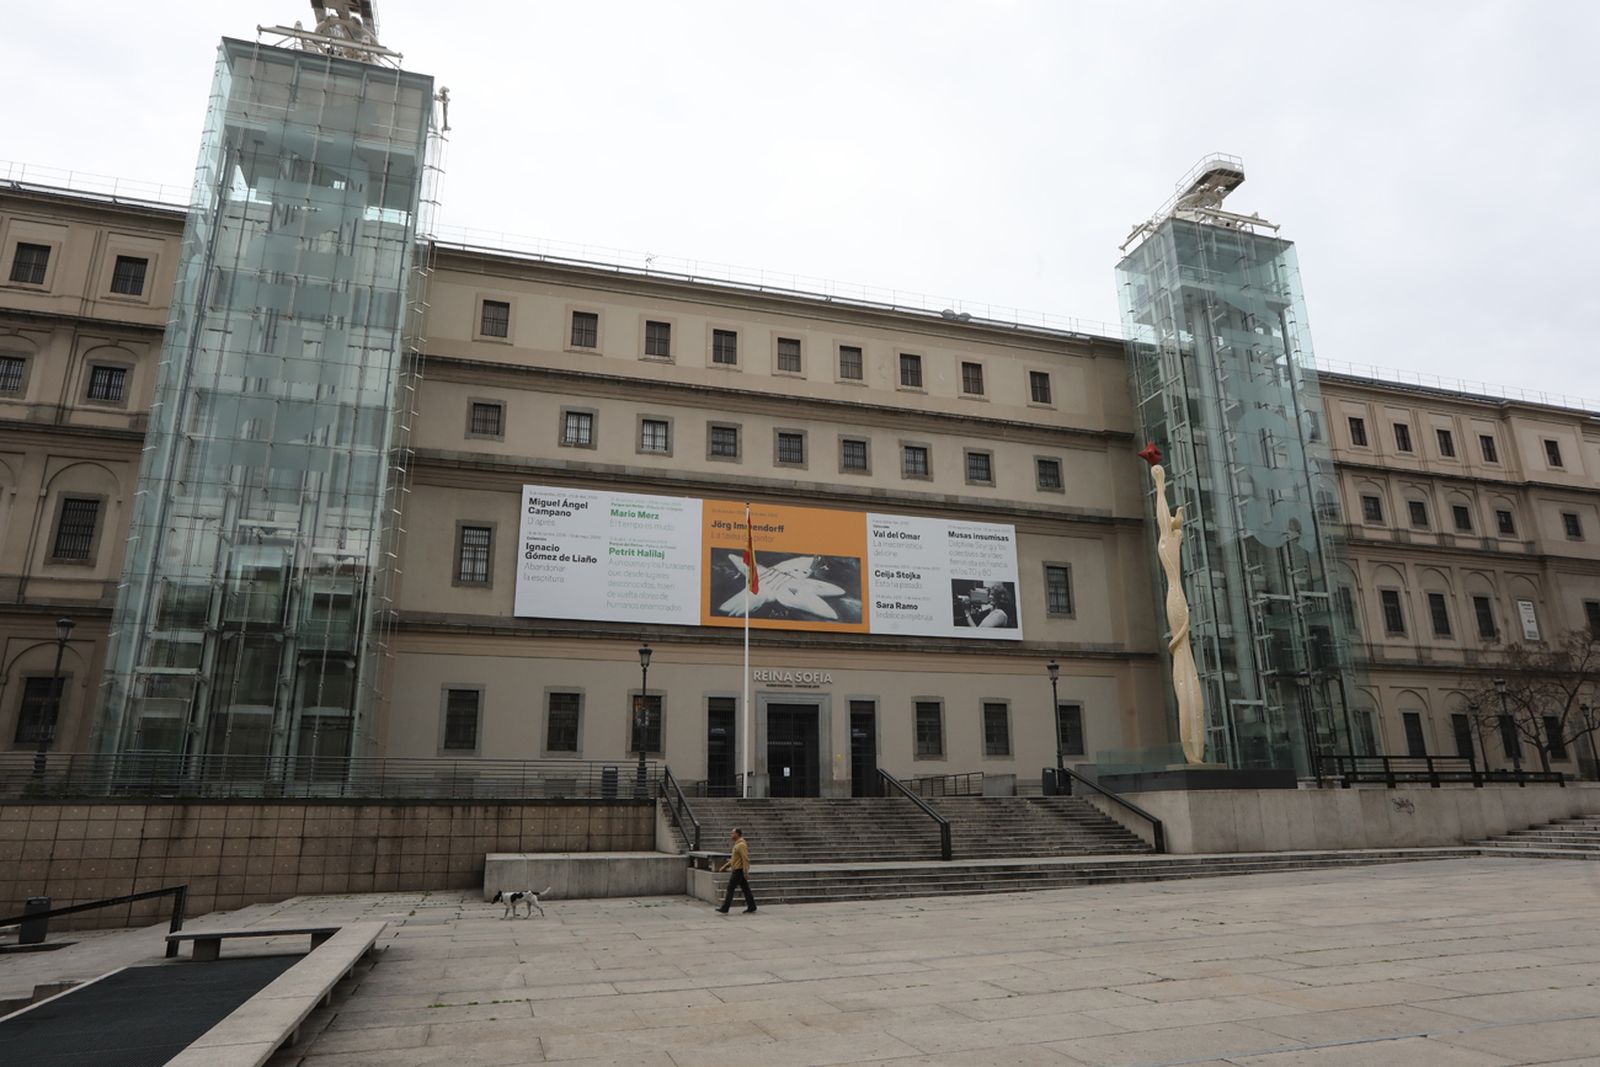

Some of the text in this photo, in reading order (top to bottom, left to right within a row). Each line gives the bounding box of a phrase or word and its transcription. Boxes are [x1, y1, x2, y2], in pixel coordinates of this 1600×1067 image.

[528, 497, 588, 510] Miguel Ángel
[528, 507, 572, 517] Campano
[610, 509, 659, 520] Mario Merz
[711, 520, 784, 533] Jörg Imendorff
[948, 530, 1009, 541] Musas insumisas
[526, 542, 560, 552] Ignacio
[525, 550, 557, 560] Gómez
[572, 554, 597, 563] Liaño
[609, 547, 665, 559] Petrit Halilaj
[875, 570, 921, 580] Ceija Stojka
[876, 601, 918, 610] Sara Ramo
[753, 670, 832, 683] REINA SOFIA
